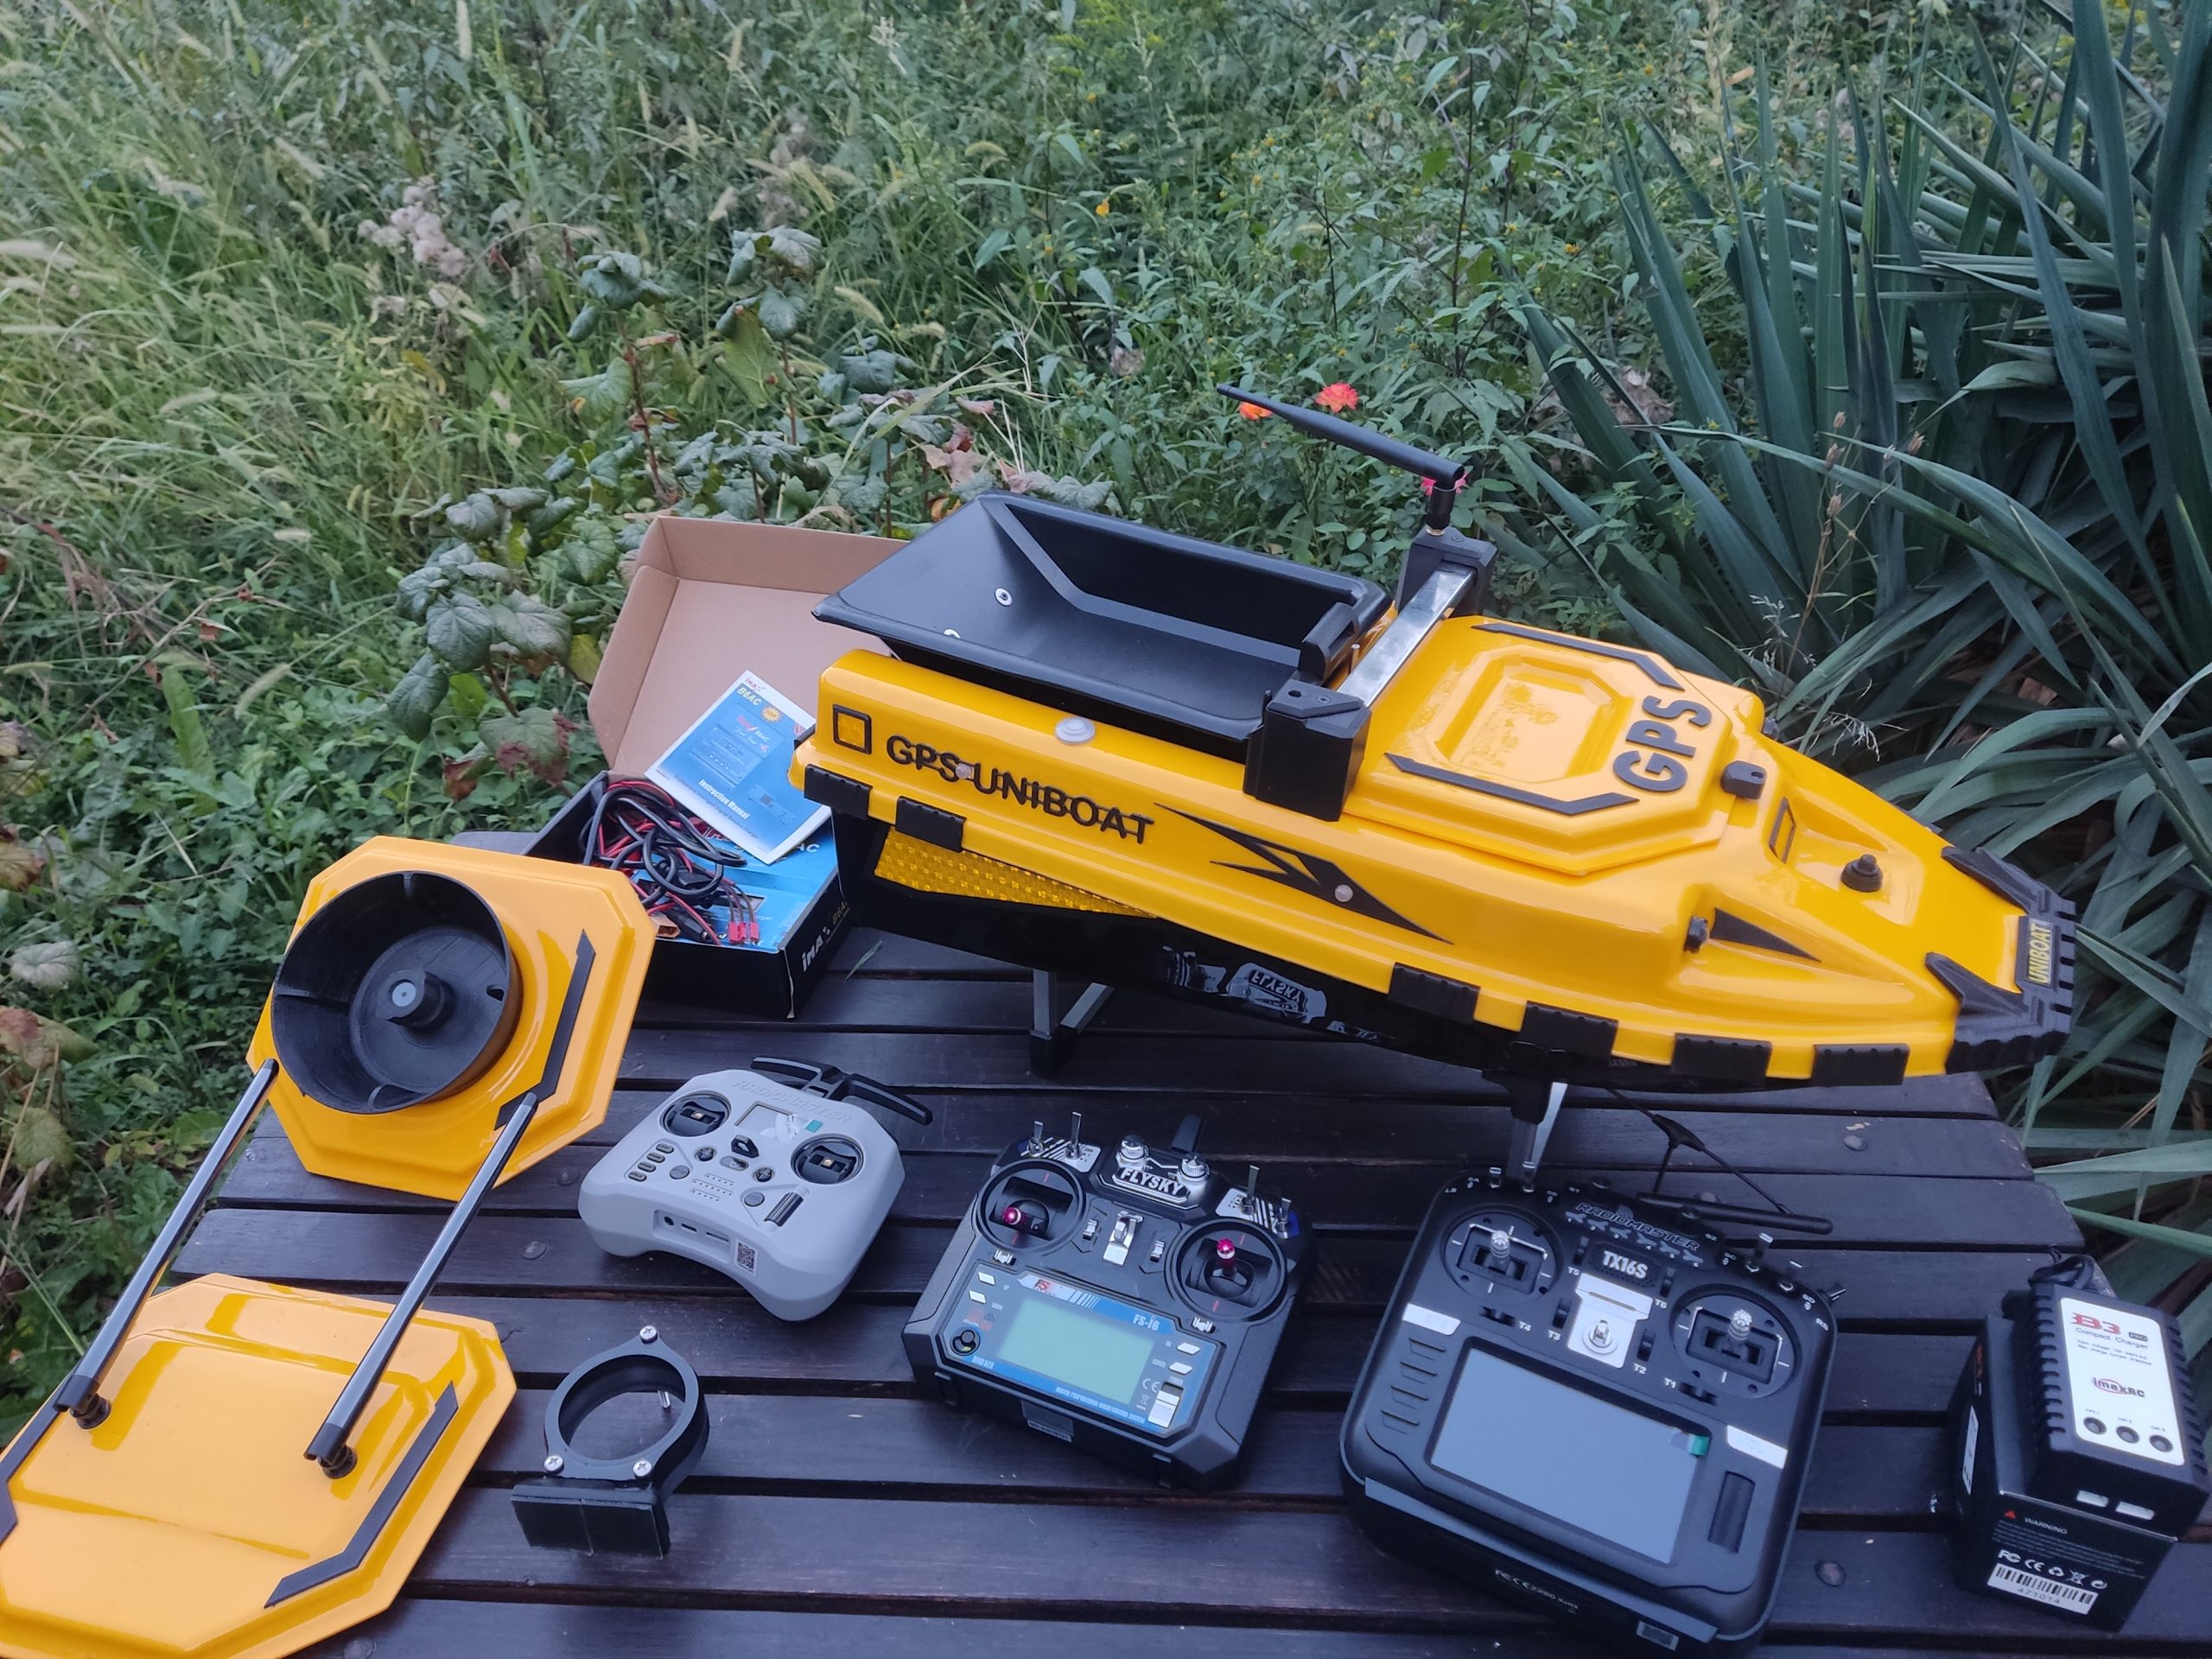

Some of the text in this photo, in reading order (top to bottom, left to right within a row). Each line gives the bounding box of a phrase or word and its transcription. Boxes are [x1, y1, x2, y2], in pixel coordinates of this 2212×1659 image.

[1613, 695, 1712, 792] GPS
[886, 734, 1154, 844] GPS UNIBOAT
[2028, 923, 2053, 983] UNIBOAT
[1121, 1167, 1185, 1196] FLYSKY
[1575, 1202, 1700, 1252] RADIOMASTER
[1568, 1266, 1580, 1276] T5
[1603, 1250, 1649, 1279] TX16S
[1655, 1299, 1668, 1309] T6
[1519, 1320, 1532, 1332] T4
[2071, 1313, 2121, 1335] B3
[1548, 1330, 1560, 1341] T3
[2075, 1327, 2148, 1349] Compact Charger
[1633, 1363, 1646, 1375] T2
[1664, 1377, 1676, 1389] T1
[2024, 1516, 2068, 1535] WARNING
[2024, 1559, 2045, 1572] CE
[2018, 1587, 2060, 1604] 471014
